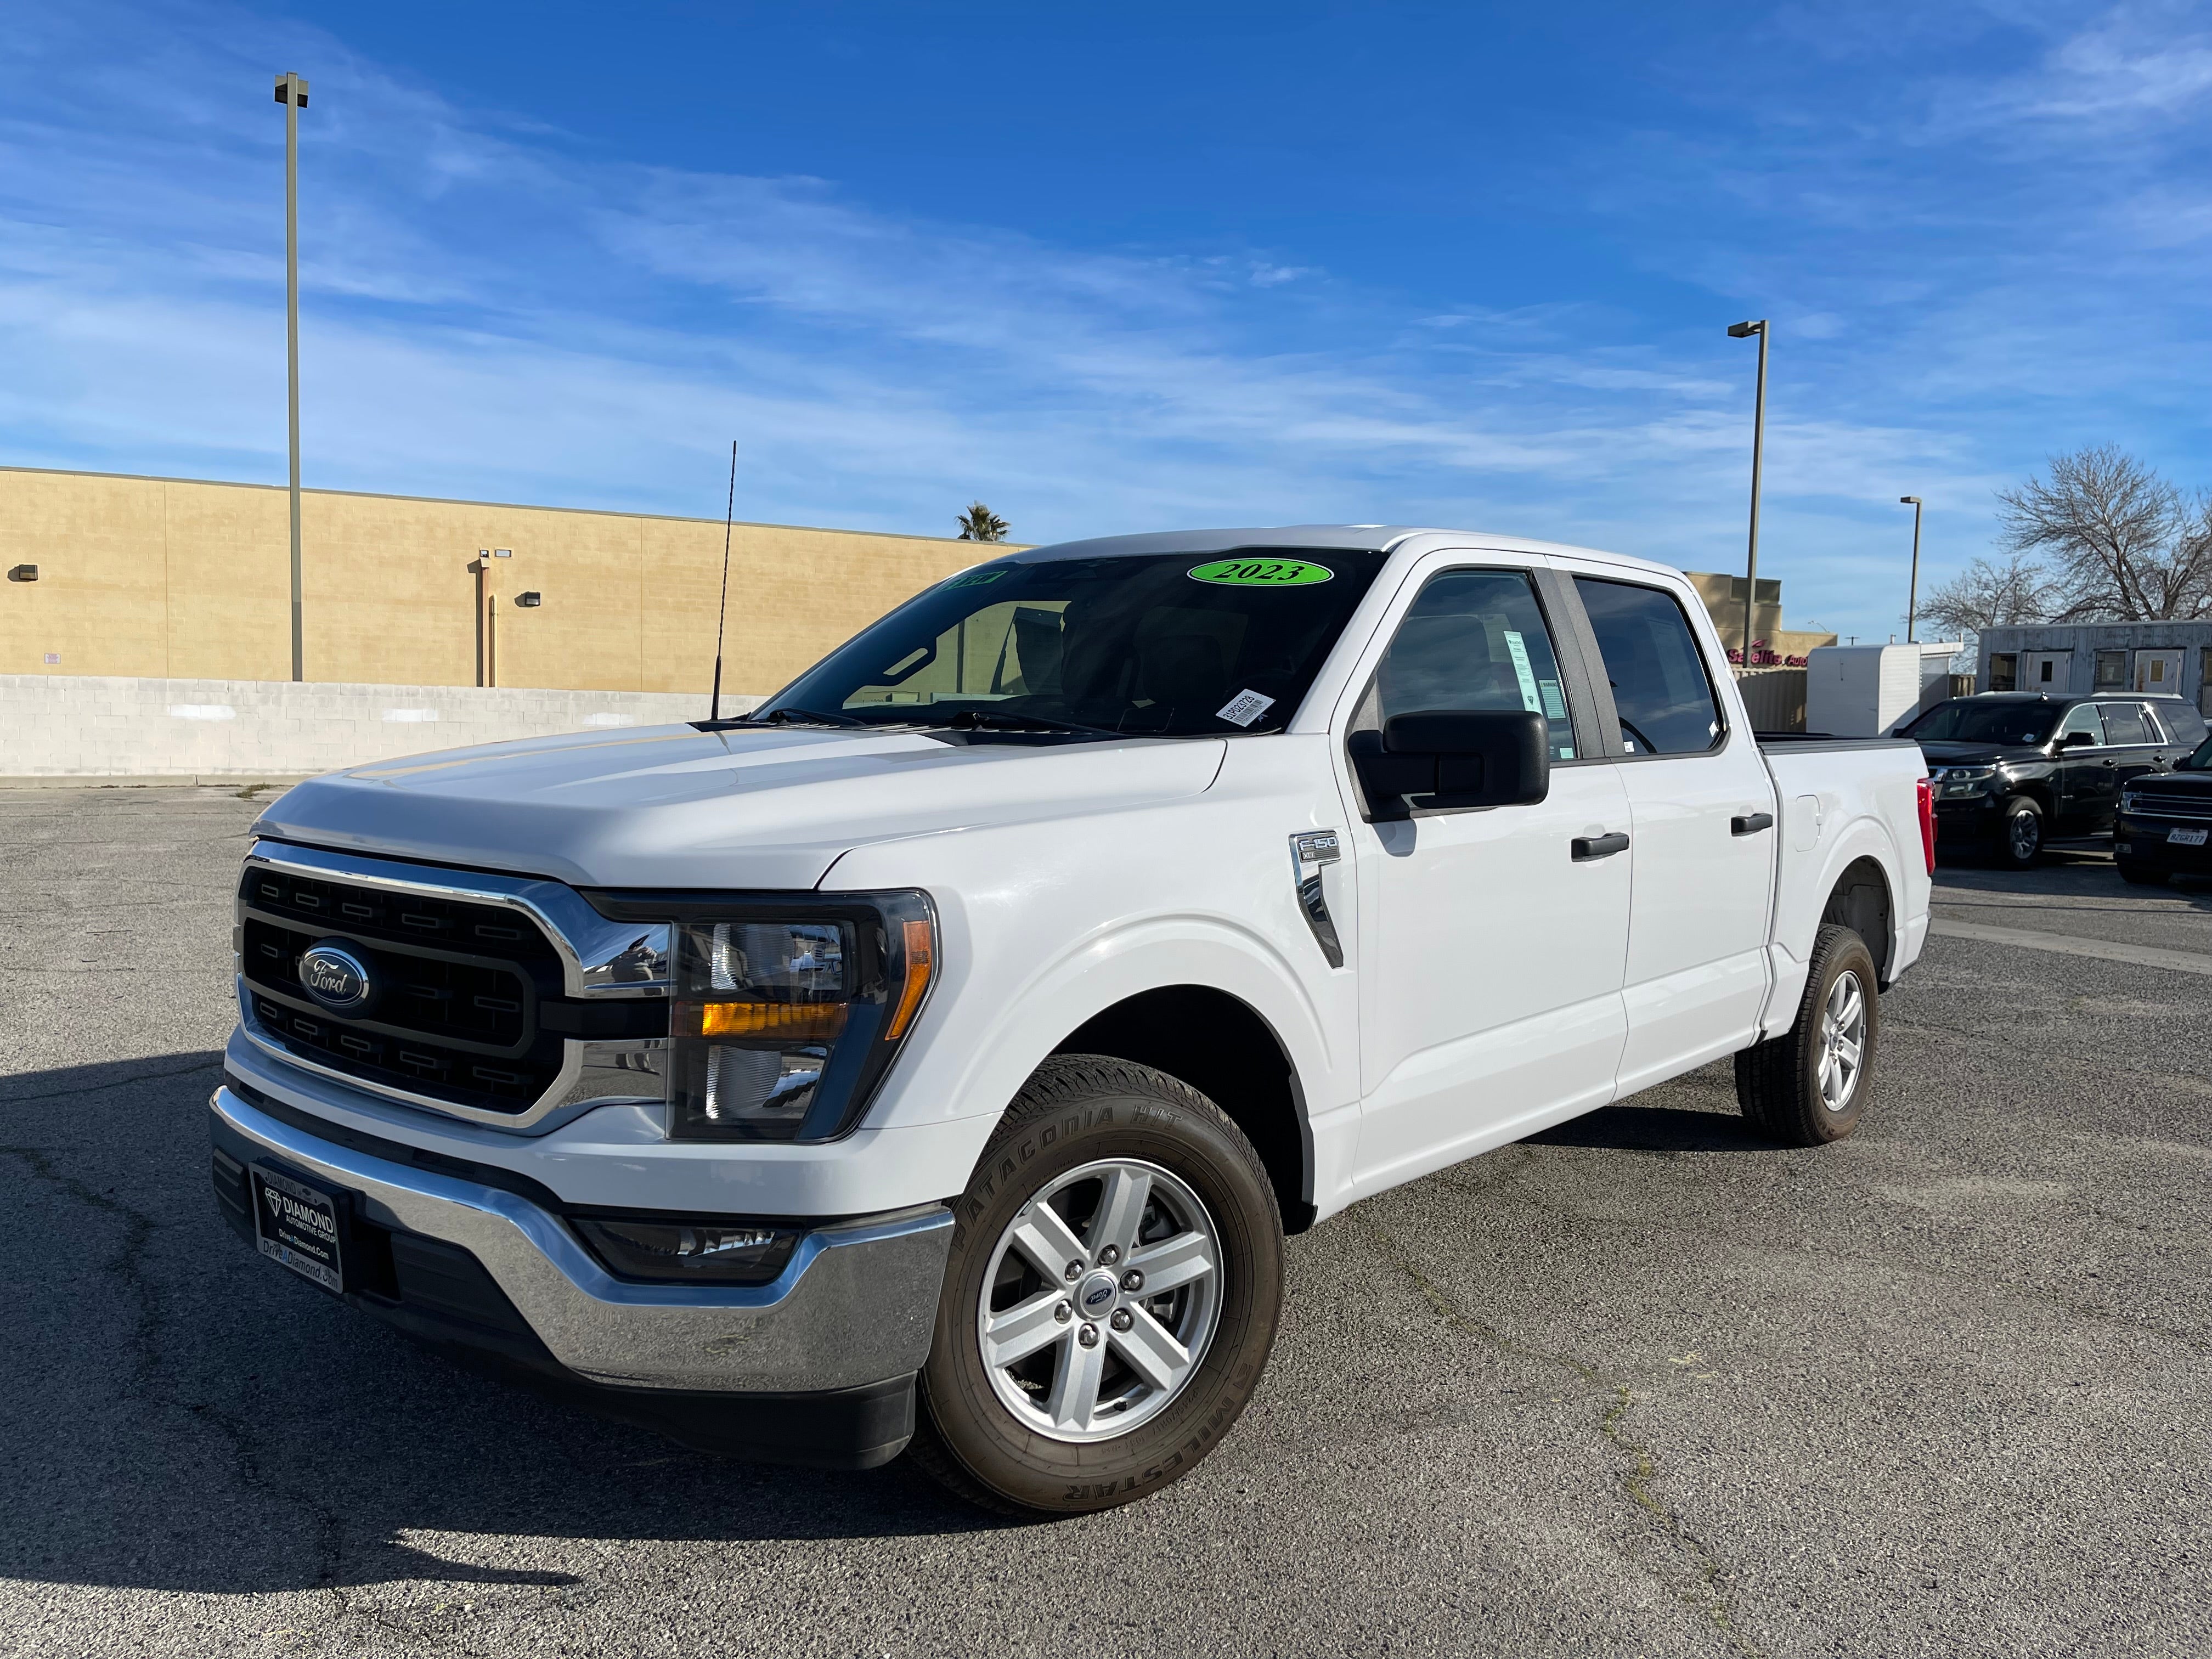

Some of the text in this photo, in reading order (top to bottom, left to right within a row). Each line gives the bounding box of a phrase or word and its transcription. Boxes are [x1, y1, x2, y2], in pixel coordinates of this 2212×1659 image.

[1213, 563, 1305, 580] 2023
[1727, 650, 1783, 665] Saelite
[1299, 837, 1338, 851] F-150
[1302, 851, 1314, 860] XLT
[311, 959, 348, 995] Ford
[283, 1197, 334, 1233] DIAMOND
[286, 1215, 336, 1244] AUTOMOTIVE GROUP
[1090, 1289, 1108, 1303] Ford
[1063, 1395, 1235, 1502] MILESTAR
